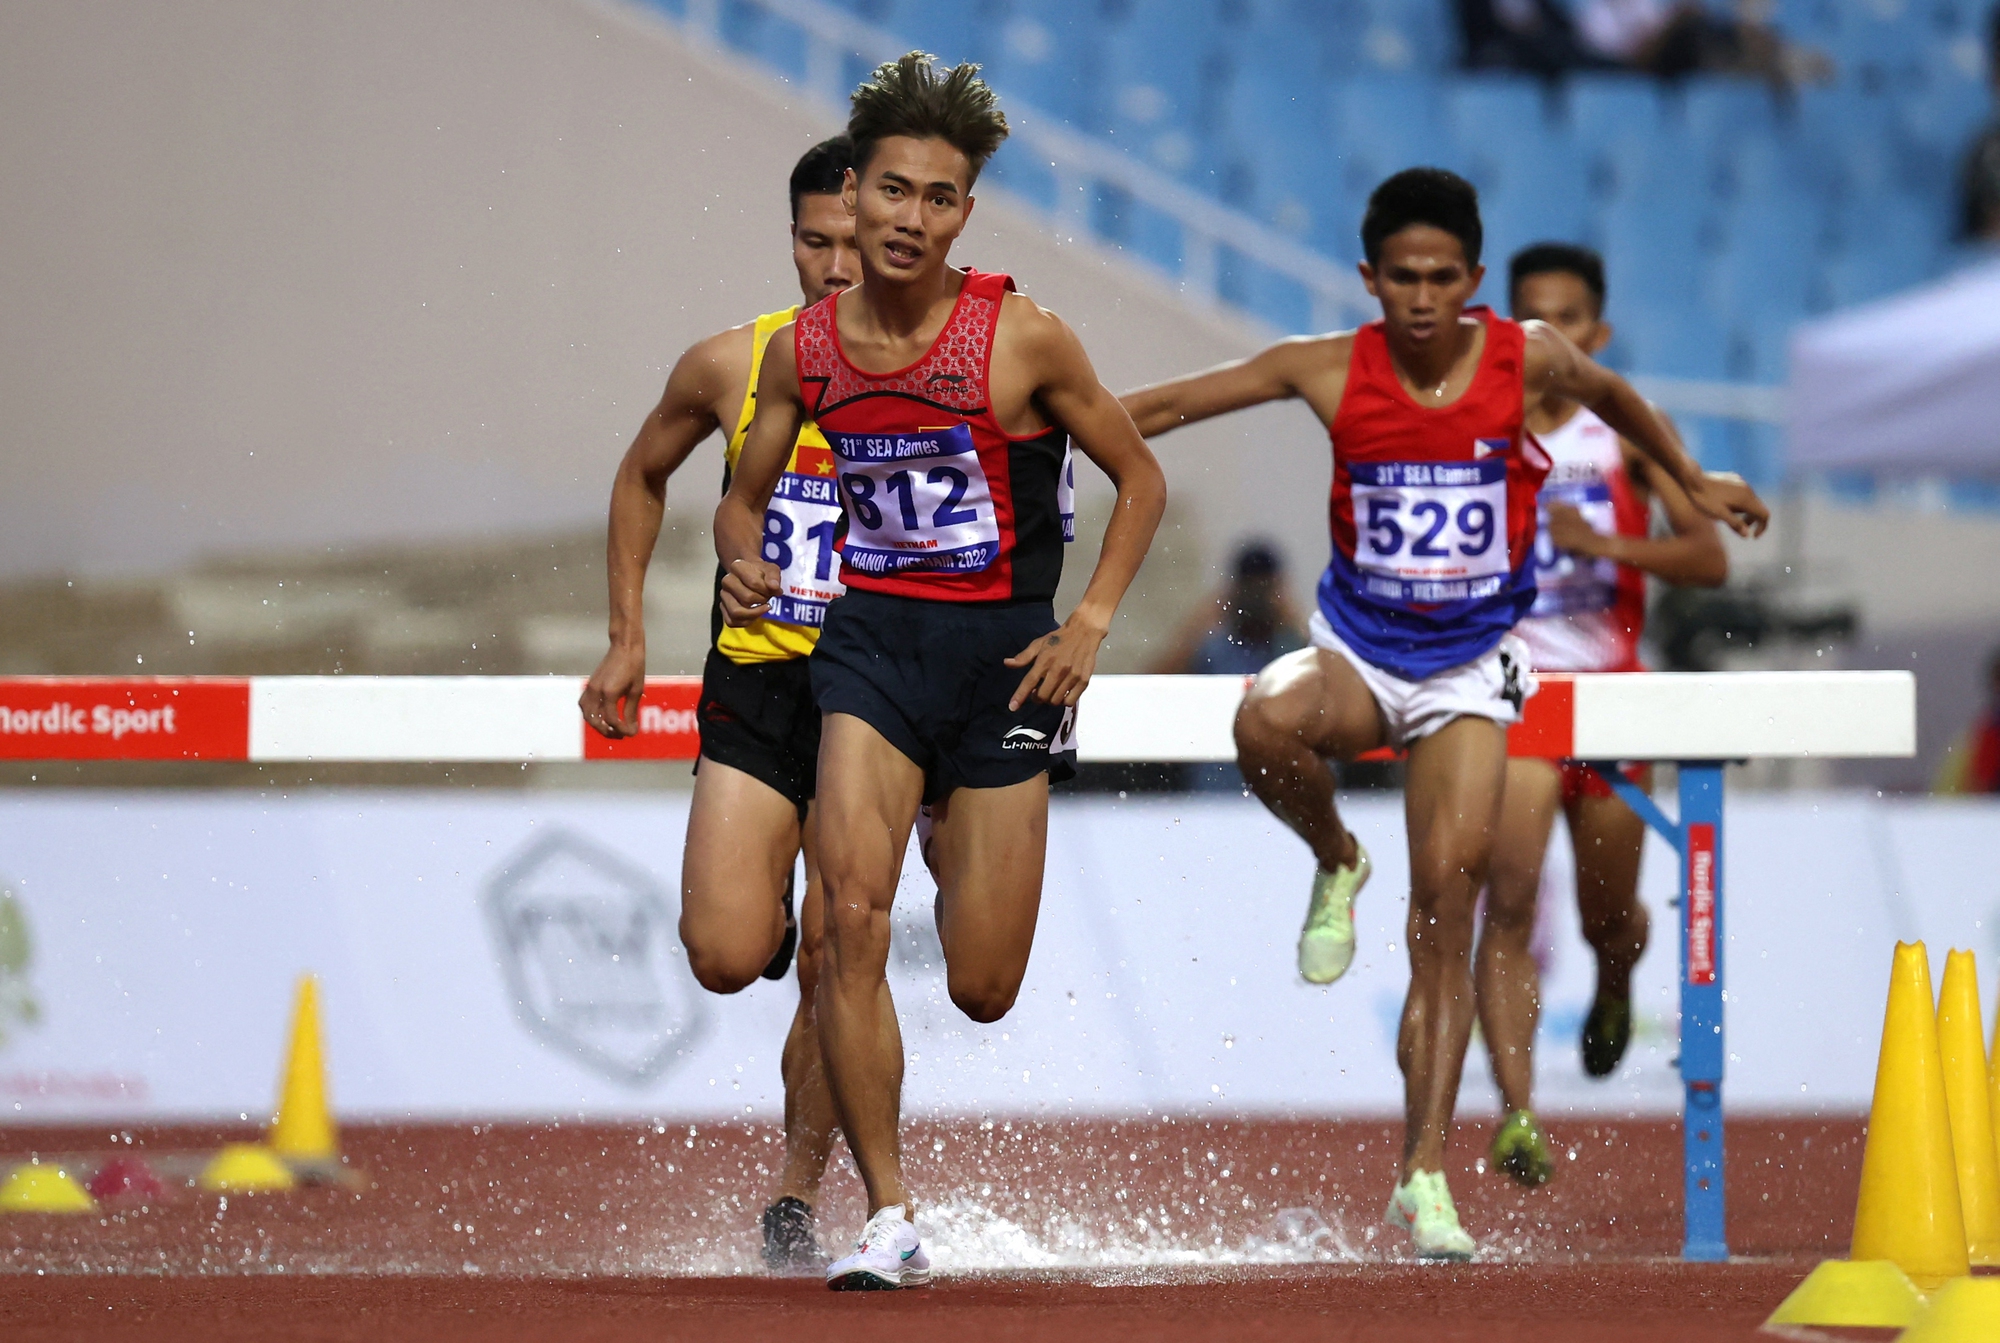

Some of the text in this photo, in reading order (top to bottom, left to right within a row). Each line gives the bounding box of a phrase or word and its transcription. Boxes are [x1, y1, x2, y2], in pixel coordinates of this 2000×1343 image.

[866, 438, 892, 458] SEA
[895, 438, 940, 458] Games
[1403, 464, 1432, 485] SEA
[1433, 464, 1481, 485] Games
[801, 479, 830, 502] SEA
[842, 466, 978, 531] 812
[1367, 500, 1495, 557] 529
[893, 539, 938, 549] VIETNAM
[851, 551, 888, 572] HANOI
[896, 554, 954, 571] VIETNAM
[956, 548, 987, 569] 2022
[92, 704, 177, 740] Sport
[1002, 740, 1049, 750] LI-NING
